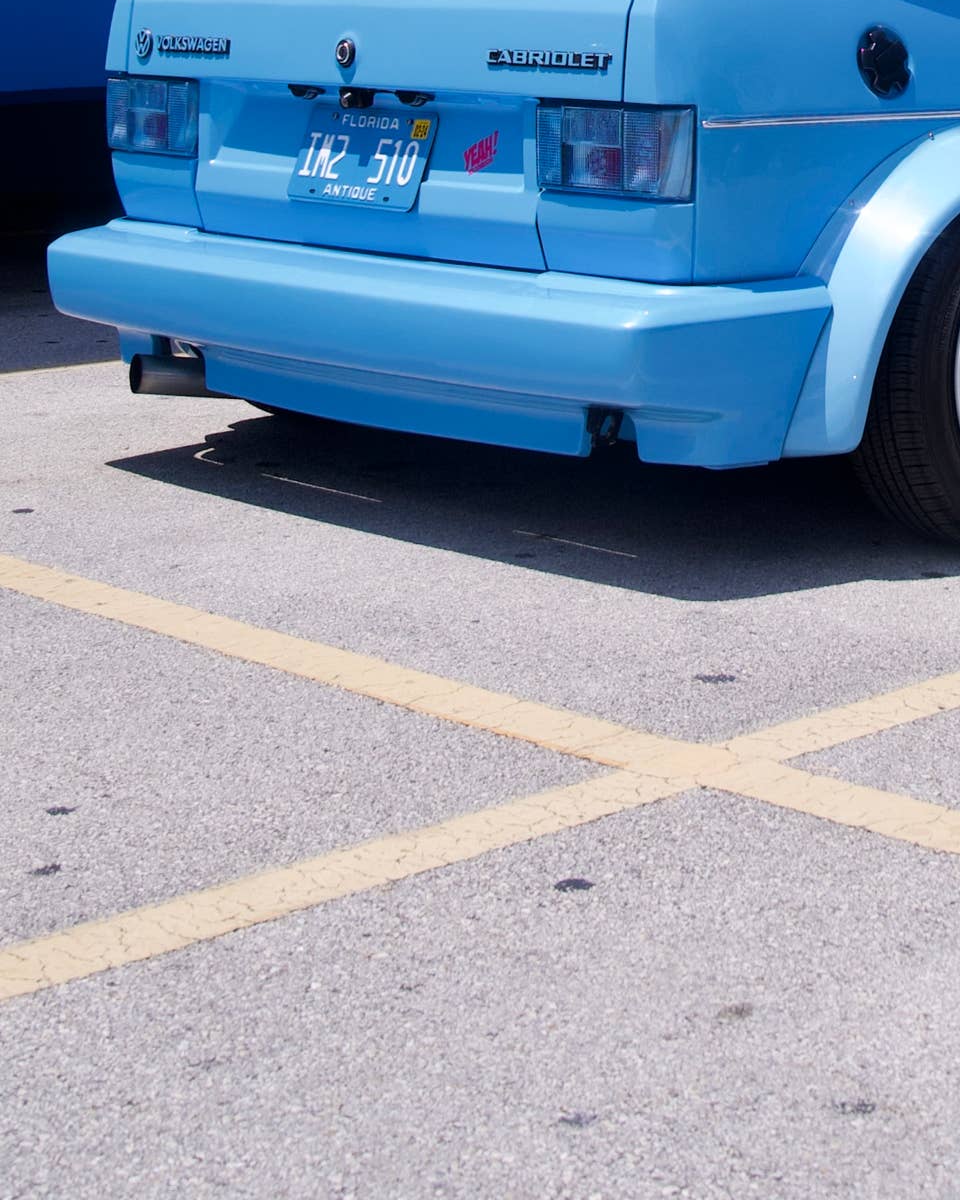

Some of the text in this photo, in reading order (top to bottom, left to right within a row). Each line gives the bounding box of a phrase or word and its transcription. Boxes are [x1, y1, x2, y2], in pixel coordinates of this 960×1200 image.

[157, 34, 231, 56] VOLKSWAGEN
[487, 49, 612, 71] CABRIOLET
[342, 114, 400, 131] FLORIDA
[463, 130, 500, 171] YEAH!
[367, 138, 420, 186] 510
[322, 183, 379, 201] ANTIQUE
